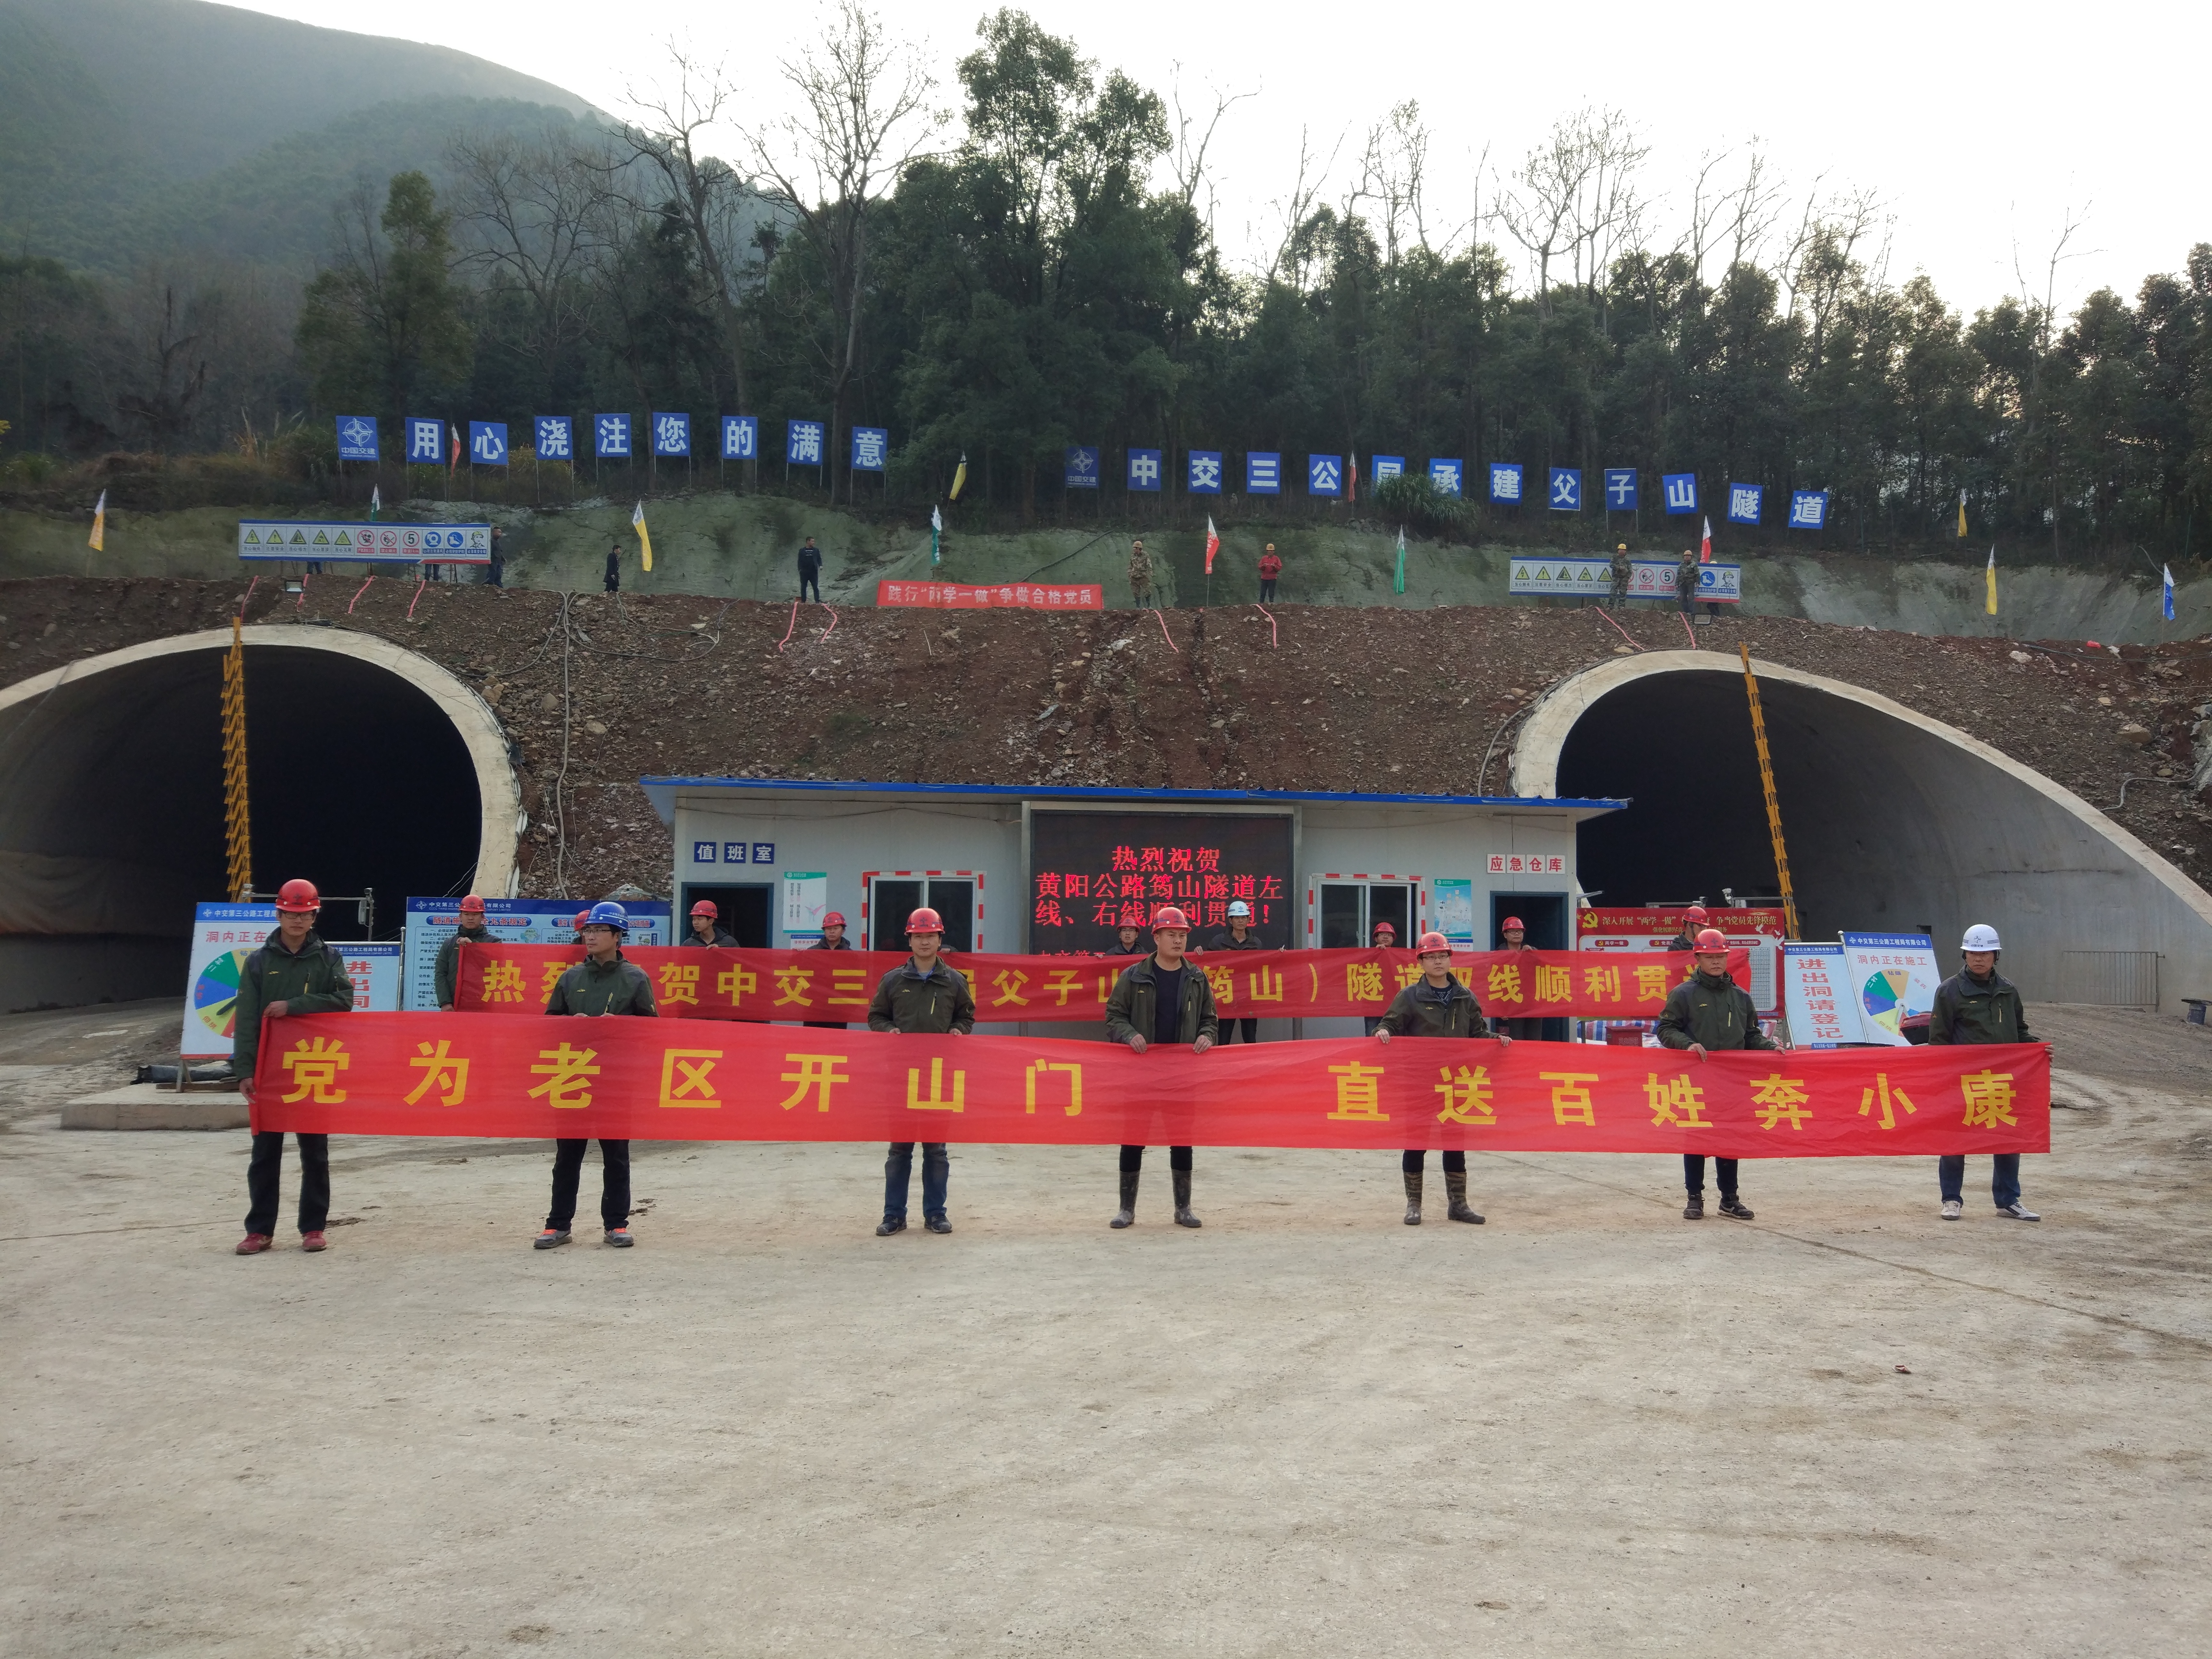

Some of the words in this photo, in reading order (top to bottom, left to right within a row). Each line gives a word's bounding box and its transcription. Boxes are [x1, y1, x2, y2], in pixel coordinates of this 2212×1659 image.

[412, 416, 886, 467] 用心浇注您的满意
[408, 533, 415, 544] 5
[1664, 572, 1671, 581] 5
[888, 585, 1092, 604] 践行“两学一做”争做合格党员
[697, 844, 772, 862] 值班室
[1112, 846, 1220, 873] 热烈祝贺
[1490, 856, 1563, 872] 应急仓库
[1035, 873, 1283, 899] 黄阳公路筠山隧道左
[433, 916, 528, 926] 隧道施全九条规定
[205, 931, 267, 943] 洞内正在
[1857, 938, 1927, 946] 中交第三公路工程局有限公司
[1857, 954, 1927, 966] 洞内正在施工
[1796, 958, 1844, 1038] 进出洞请登记
[281, 1036, 1084, 1118] 党为老区开山门
[1327, 1060, 2019, 1129] 直送百姓奔小康
